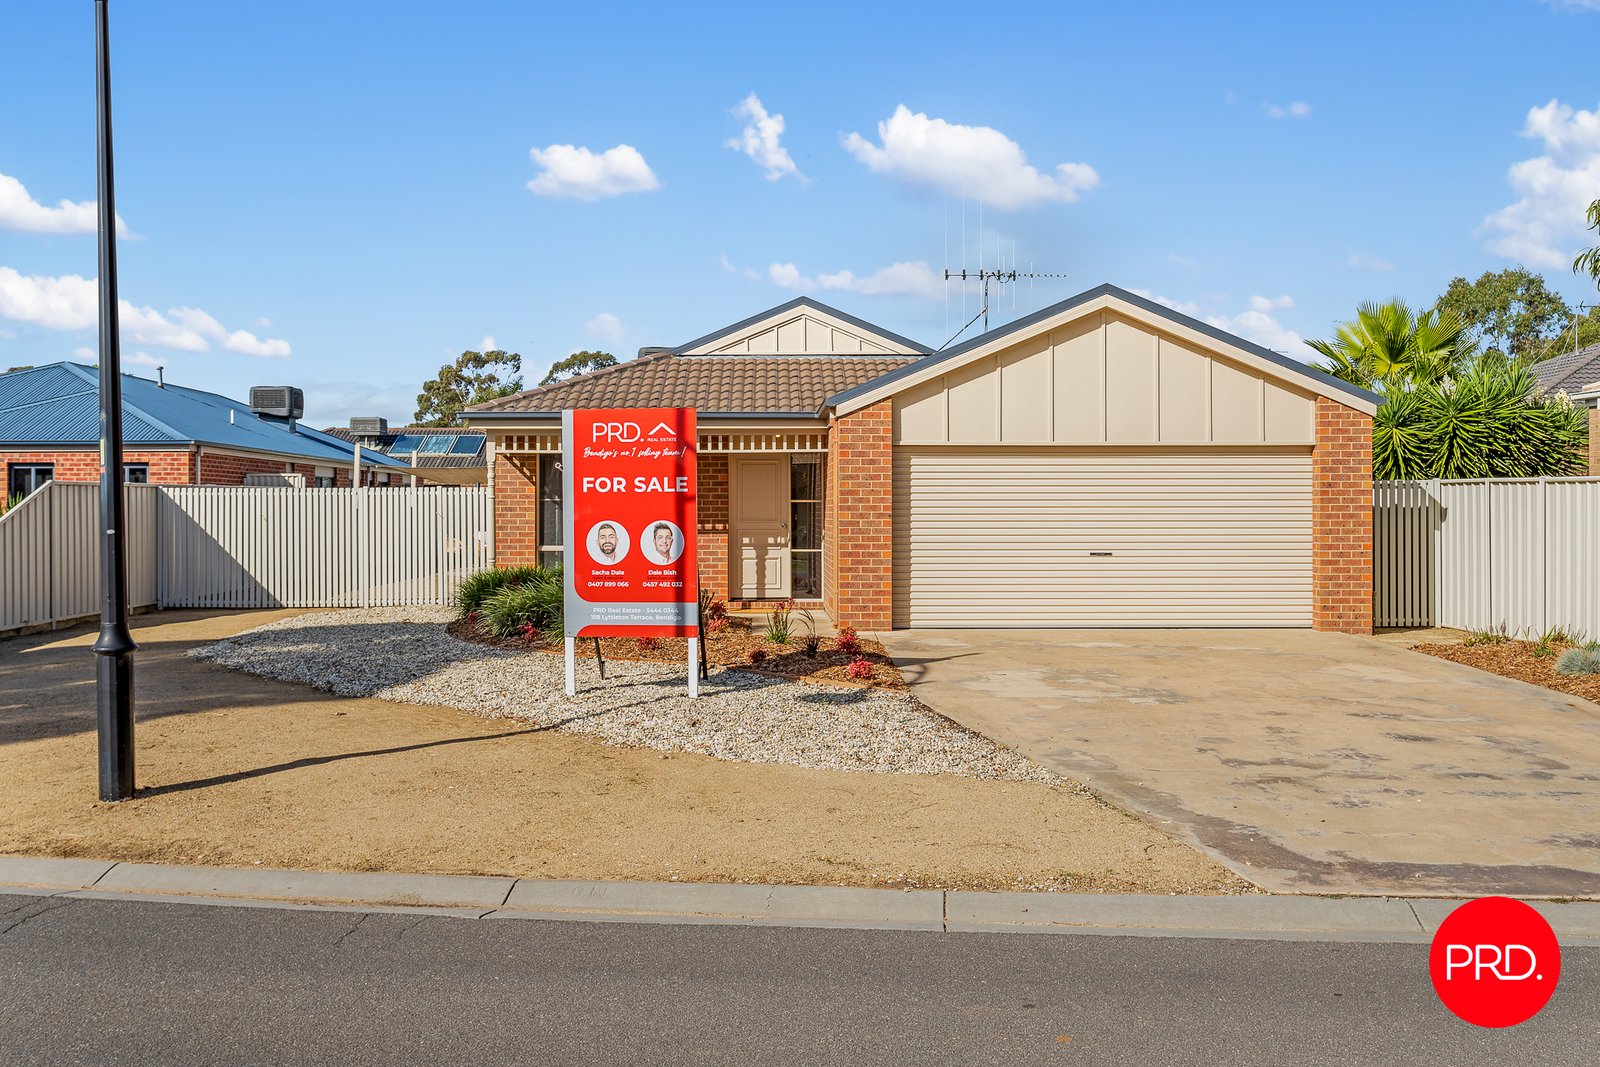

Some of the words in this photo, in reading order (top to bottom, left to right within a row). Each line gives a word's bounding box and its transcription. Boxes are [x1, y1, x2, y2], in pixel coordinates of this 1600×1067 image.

[592, 421, 645, 443] PRD.
[583, 446, 618, 460] Bendigo's
[637, 446, 661, 460] selling
[582, 476, 627, 493] FOR
[633, 476, 689, 493] SALE
[656, 614, 682, 622] Bendigo
